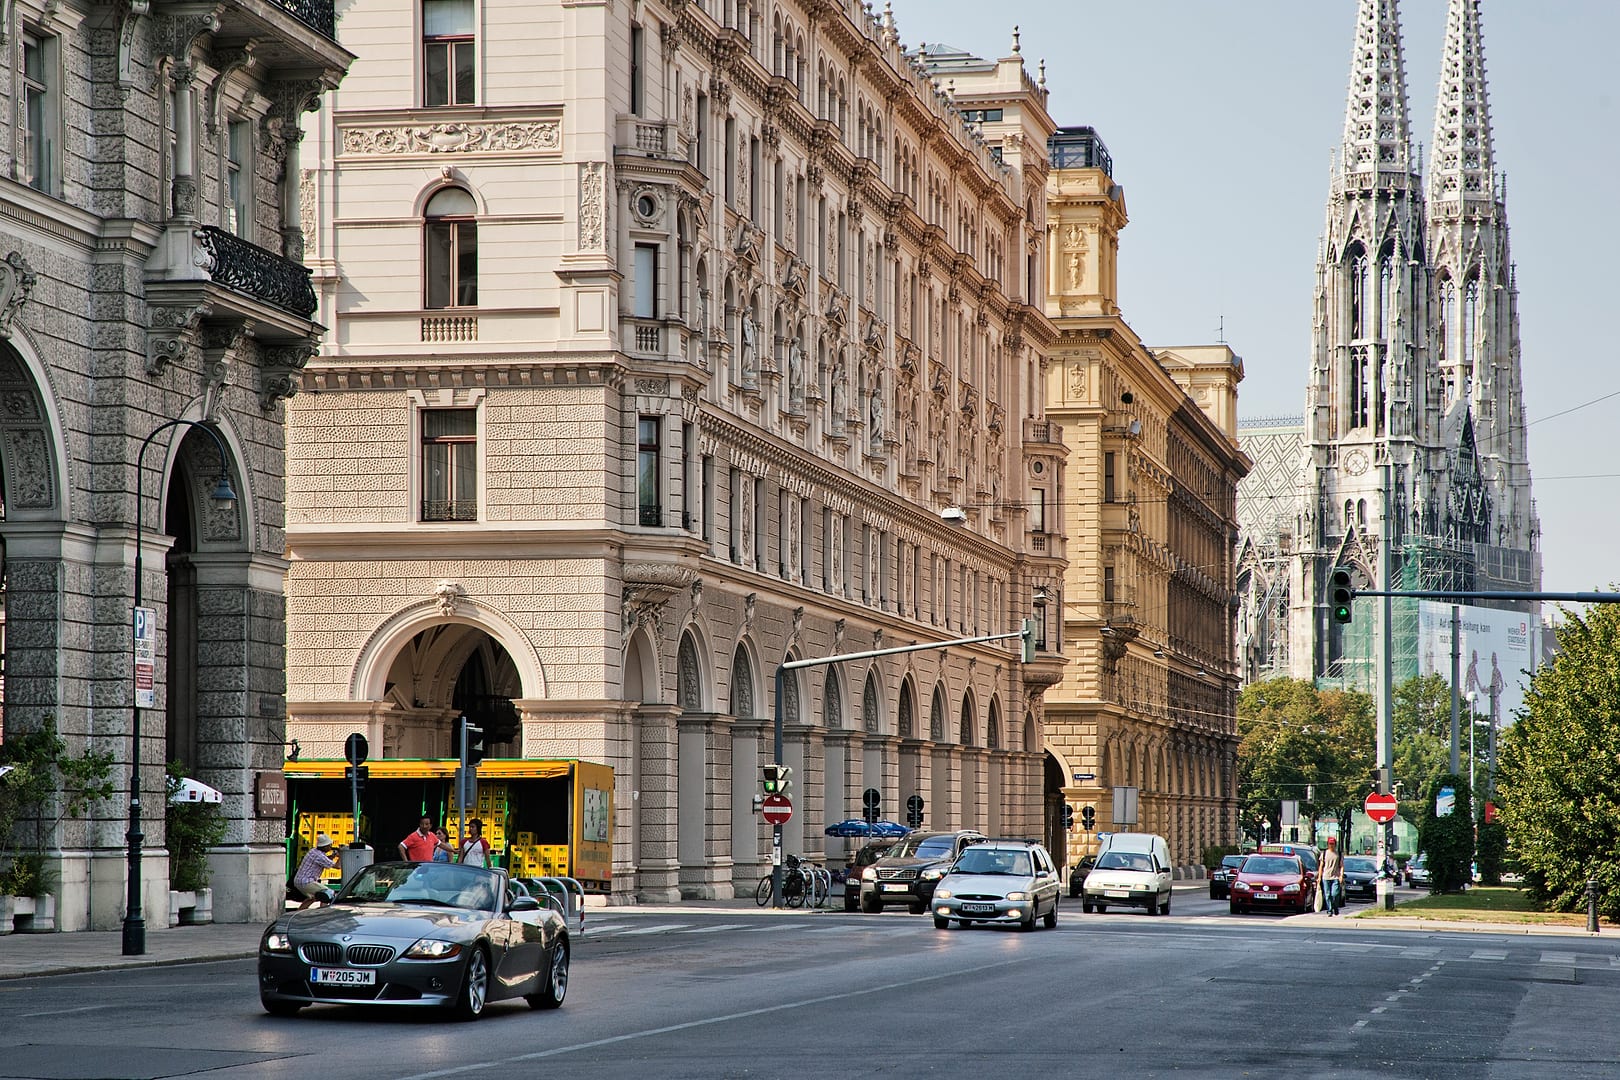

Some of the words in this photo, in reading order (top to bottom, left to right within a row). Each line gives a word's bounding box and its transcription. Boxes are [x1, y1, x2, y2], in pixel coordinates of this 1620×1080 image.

[136, 611, 144, 638] P
[1480, 622, 1491, 633] kann
[261, 788, 285, 805] EINSTEIN
[336, 971, 355, 982] 205
[356, 972, 370, 983] JM
